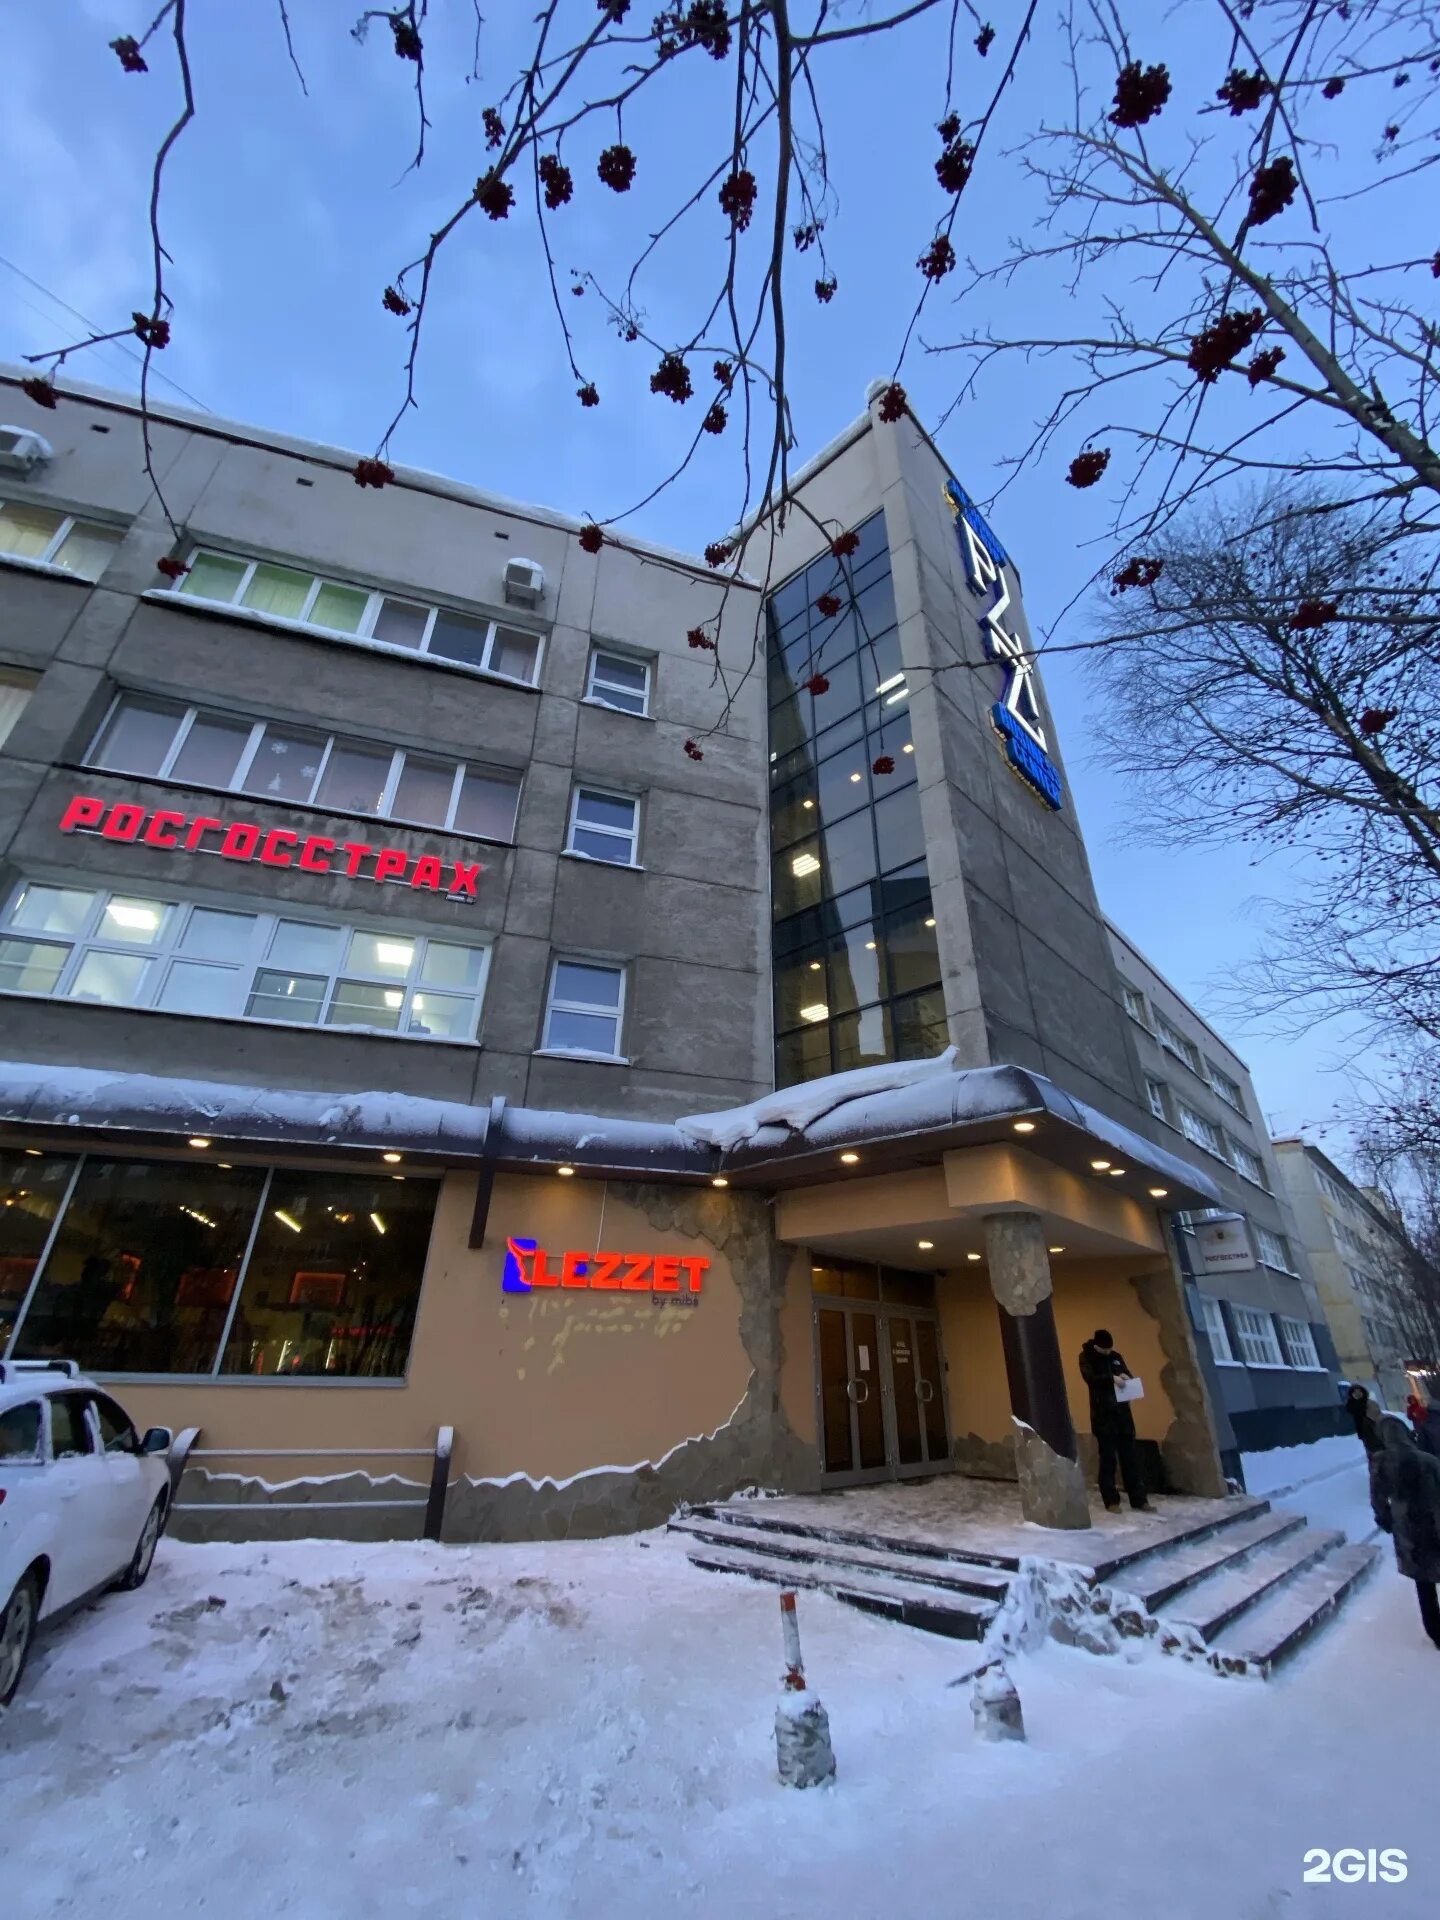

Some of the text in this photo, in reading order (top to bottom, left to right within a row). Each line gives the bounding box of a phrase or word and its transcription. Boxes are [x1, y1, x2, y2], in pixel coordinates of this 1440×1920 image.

[59, 795, 481, 897] РОСГОССТРАХ
[530, 1250, 711, 1292] LEZZET
[652, 1291, 666, 1308] by
